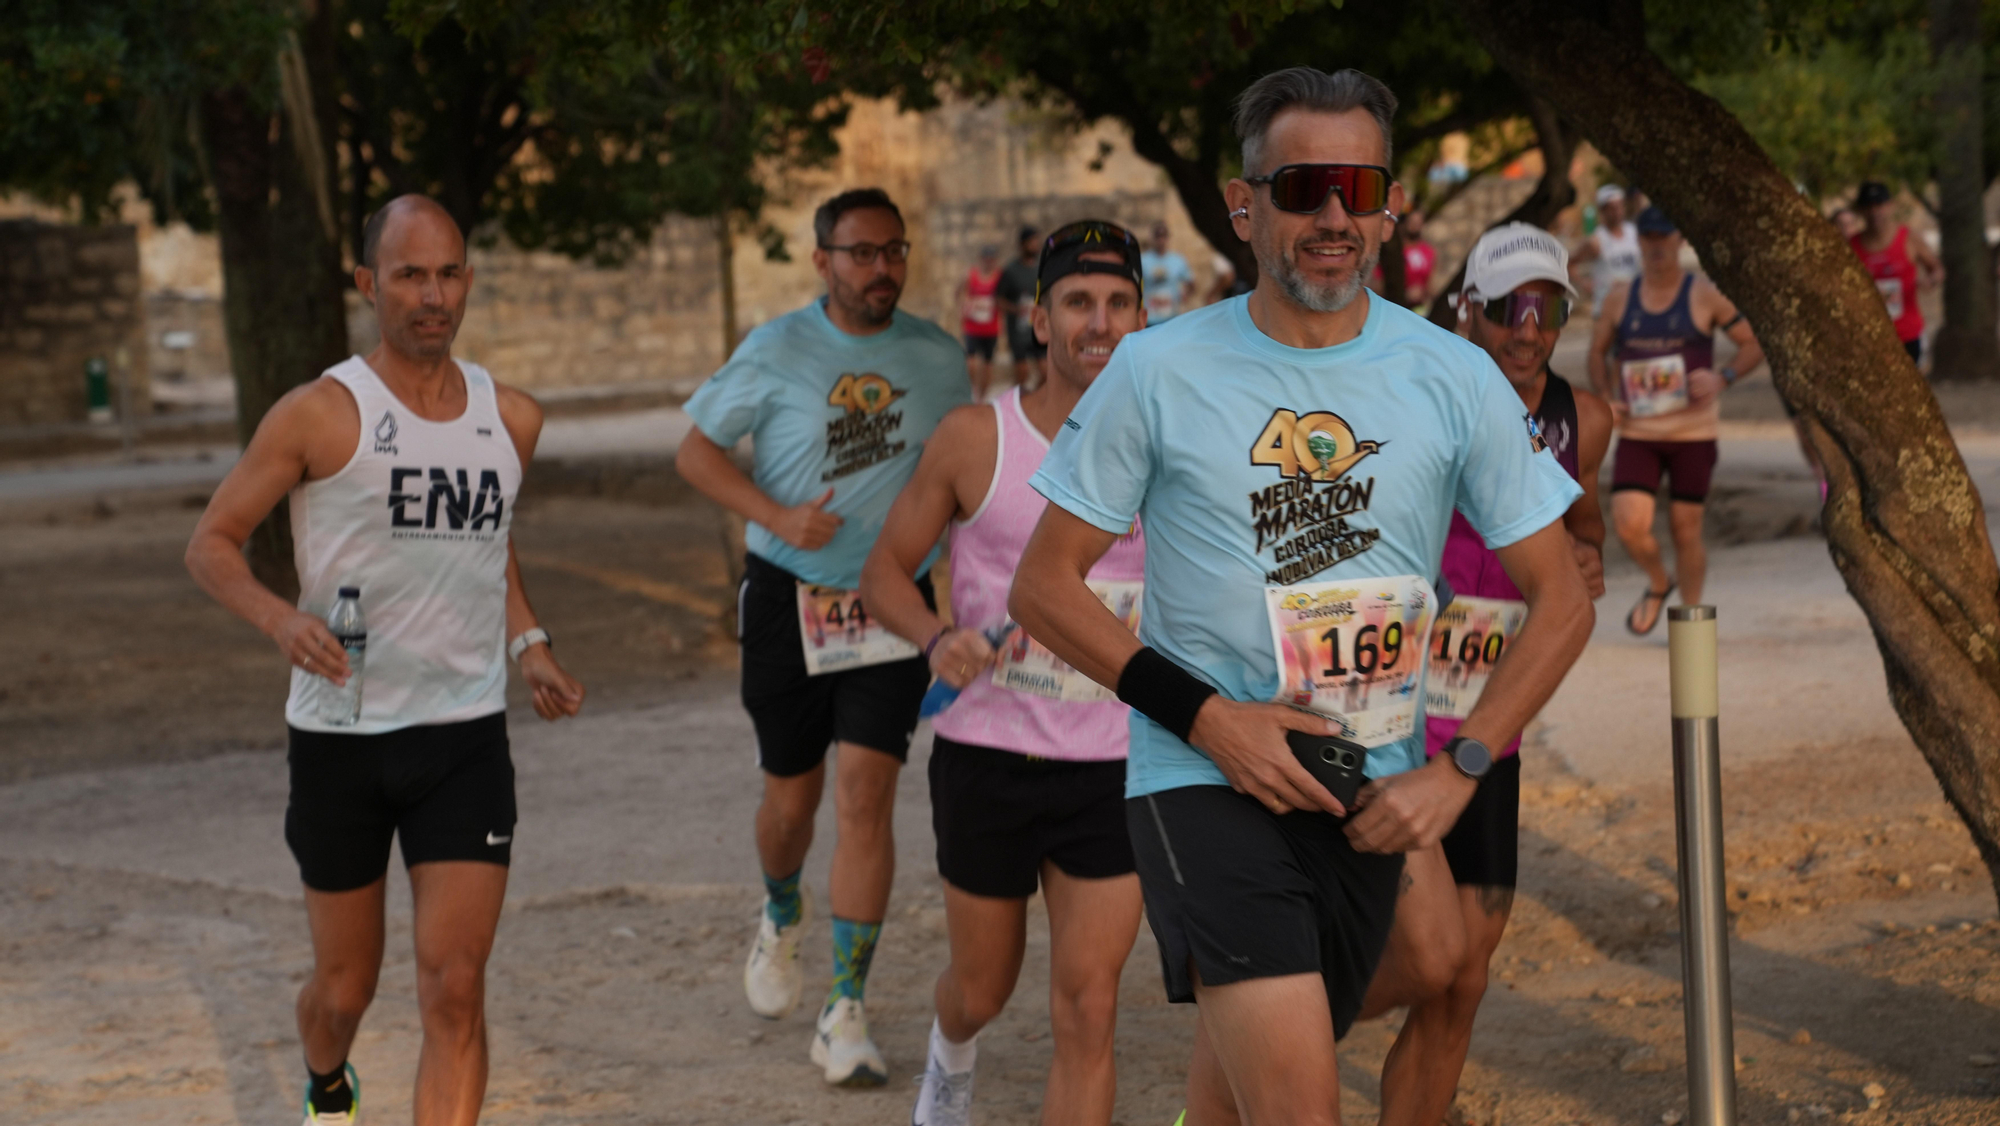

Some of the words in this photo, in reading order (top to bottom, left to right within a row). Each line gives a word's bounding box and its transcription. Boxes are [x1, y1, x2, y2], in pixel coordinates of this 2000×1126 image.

[827, 373, 902, 414] 40
[1250, 407, 1380, 483] 40
[388, 467, 503, 531] ENA
[1249, 473, 1313, 517] MEDIA
[1252, 476, 1375, 554] MARATÓN
[1320, 621, 1403, 678] 169
[1433, 630, 1504, 665] 160
